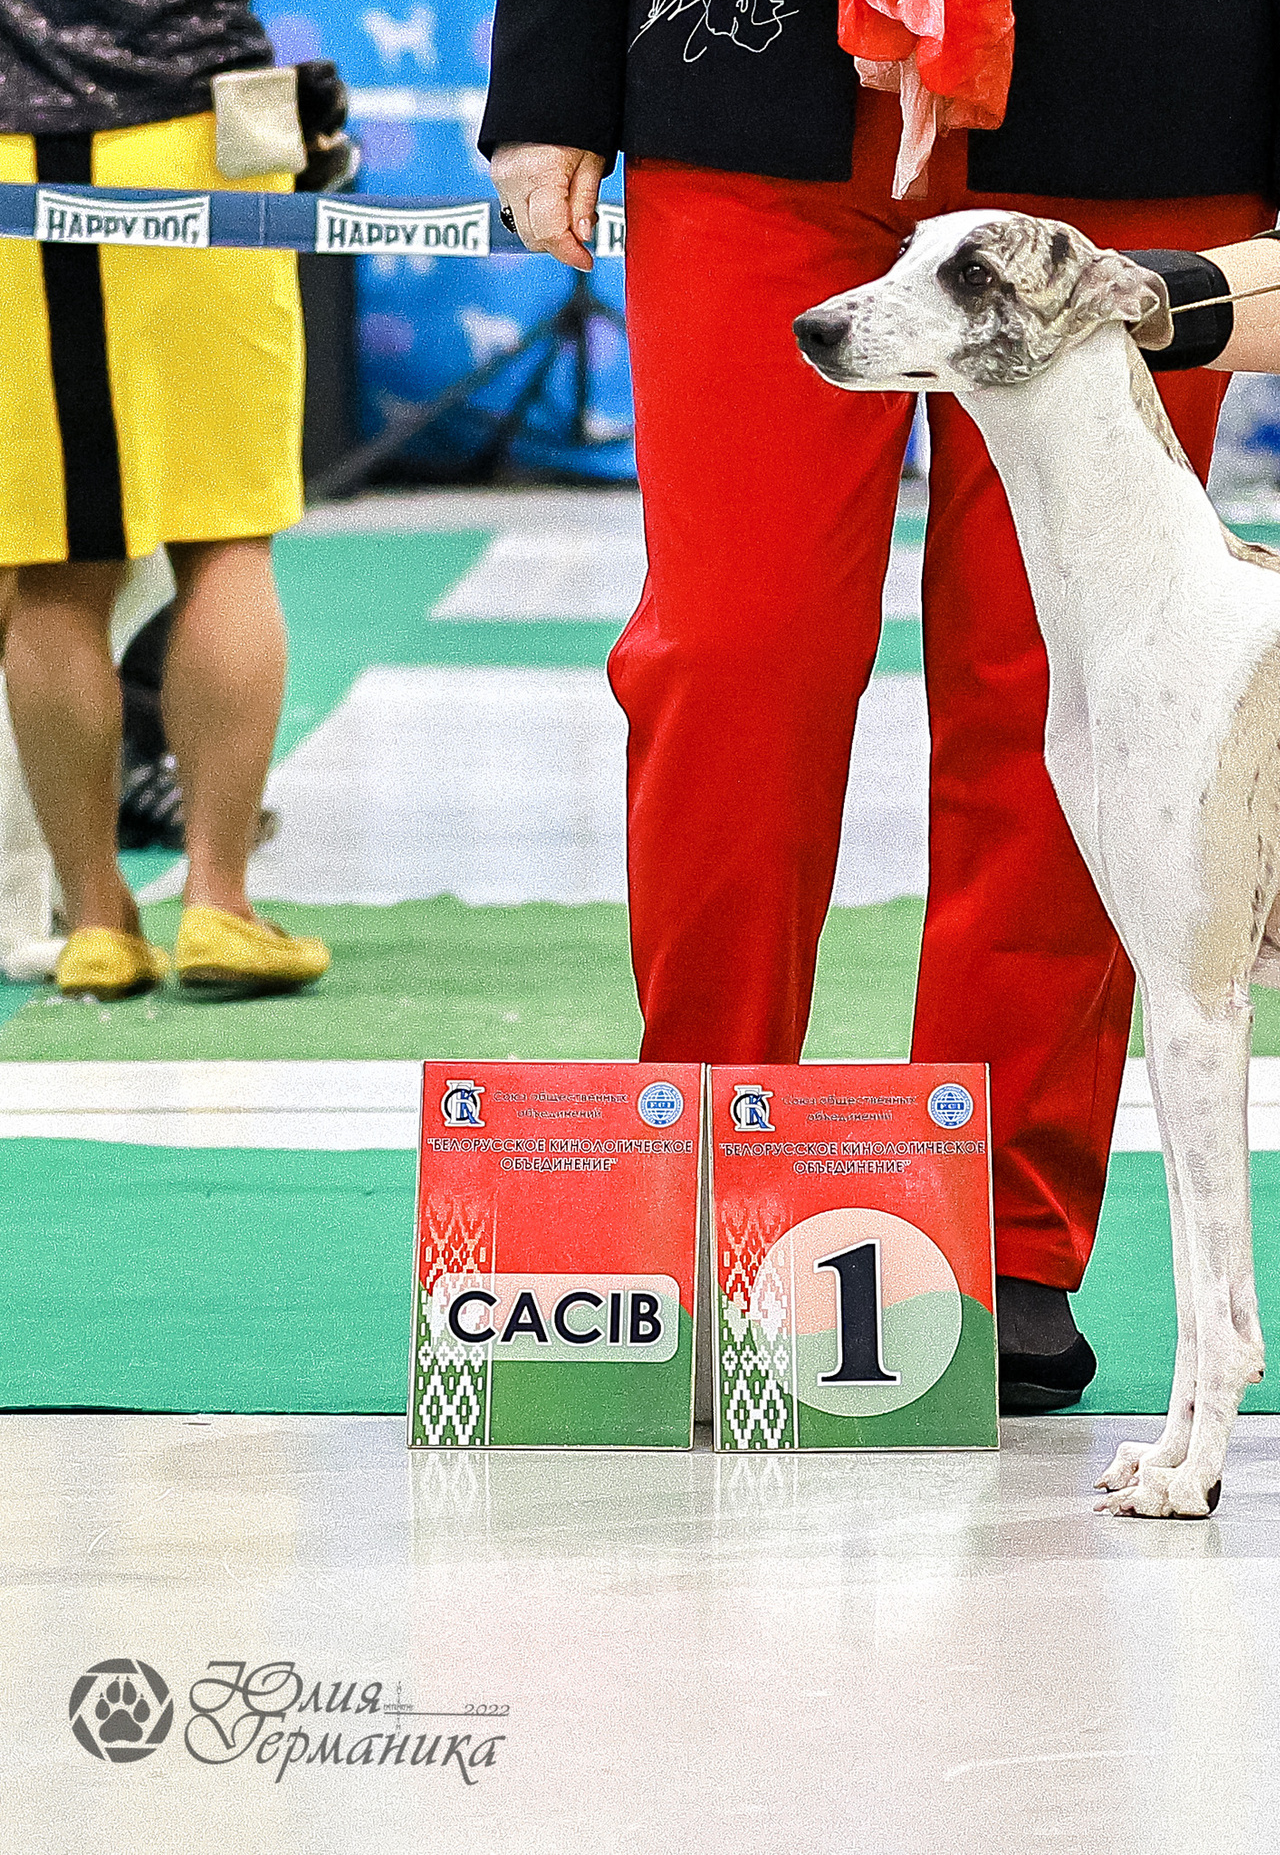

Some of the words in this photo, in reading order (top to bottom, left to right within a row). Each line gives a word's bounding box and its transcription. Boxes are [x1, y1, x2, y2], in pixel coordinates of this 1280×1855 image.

[48, 207, 138, 241] HAPPY
[143, 212, 200, 245] DOG
[328, 215, 418, 248] HAPPY
[424, 219, 480, 250] DOG
[427, 1138, 546, 1153] "БЕЛОРУССКОЕ
[550, 1138, 693, 1154] КИНОЛОГИЧЕСКОЕ
[840, 1140, 986, 1155] КИНОЛОГИЧЕСКОЕ
[500, 1157, 619, 1173] ОБЪЕДИНЕНИЕ"
[447, 1290, 664, 1345] CACIB
[816, 1240, 899, 1385] 1
